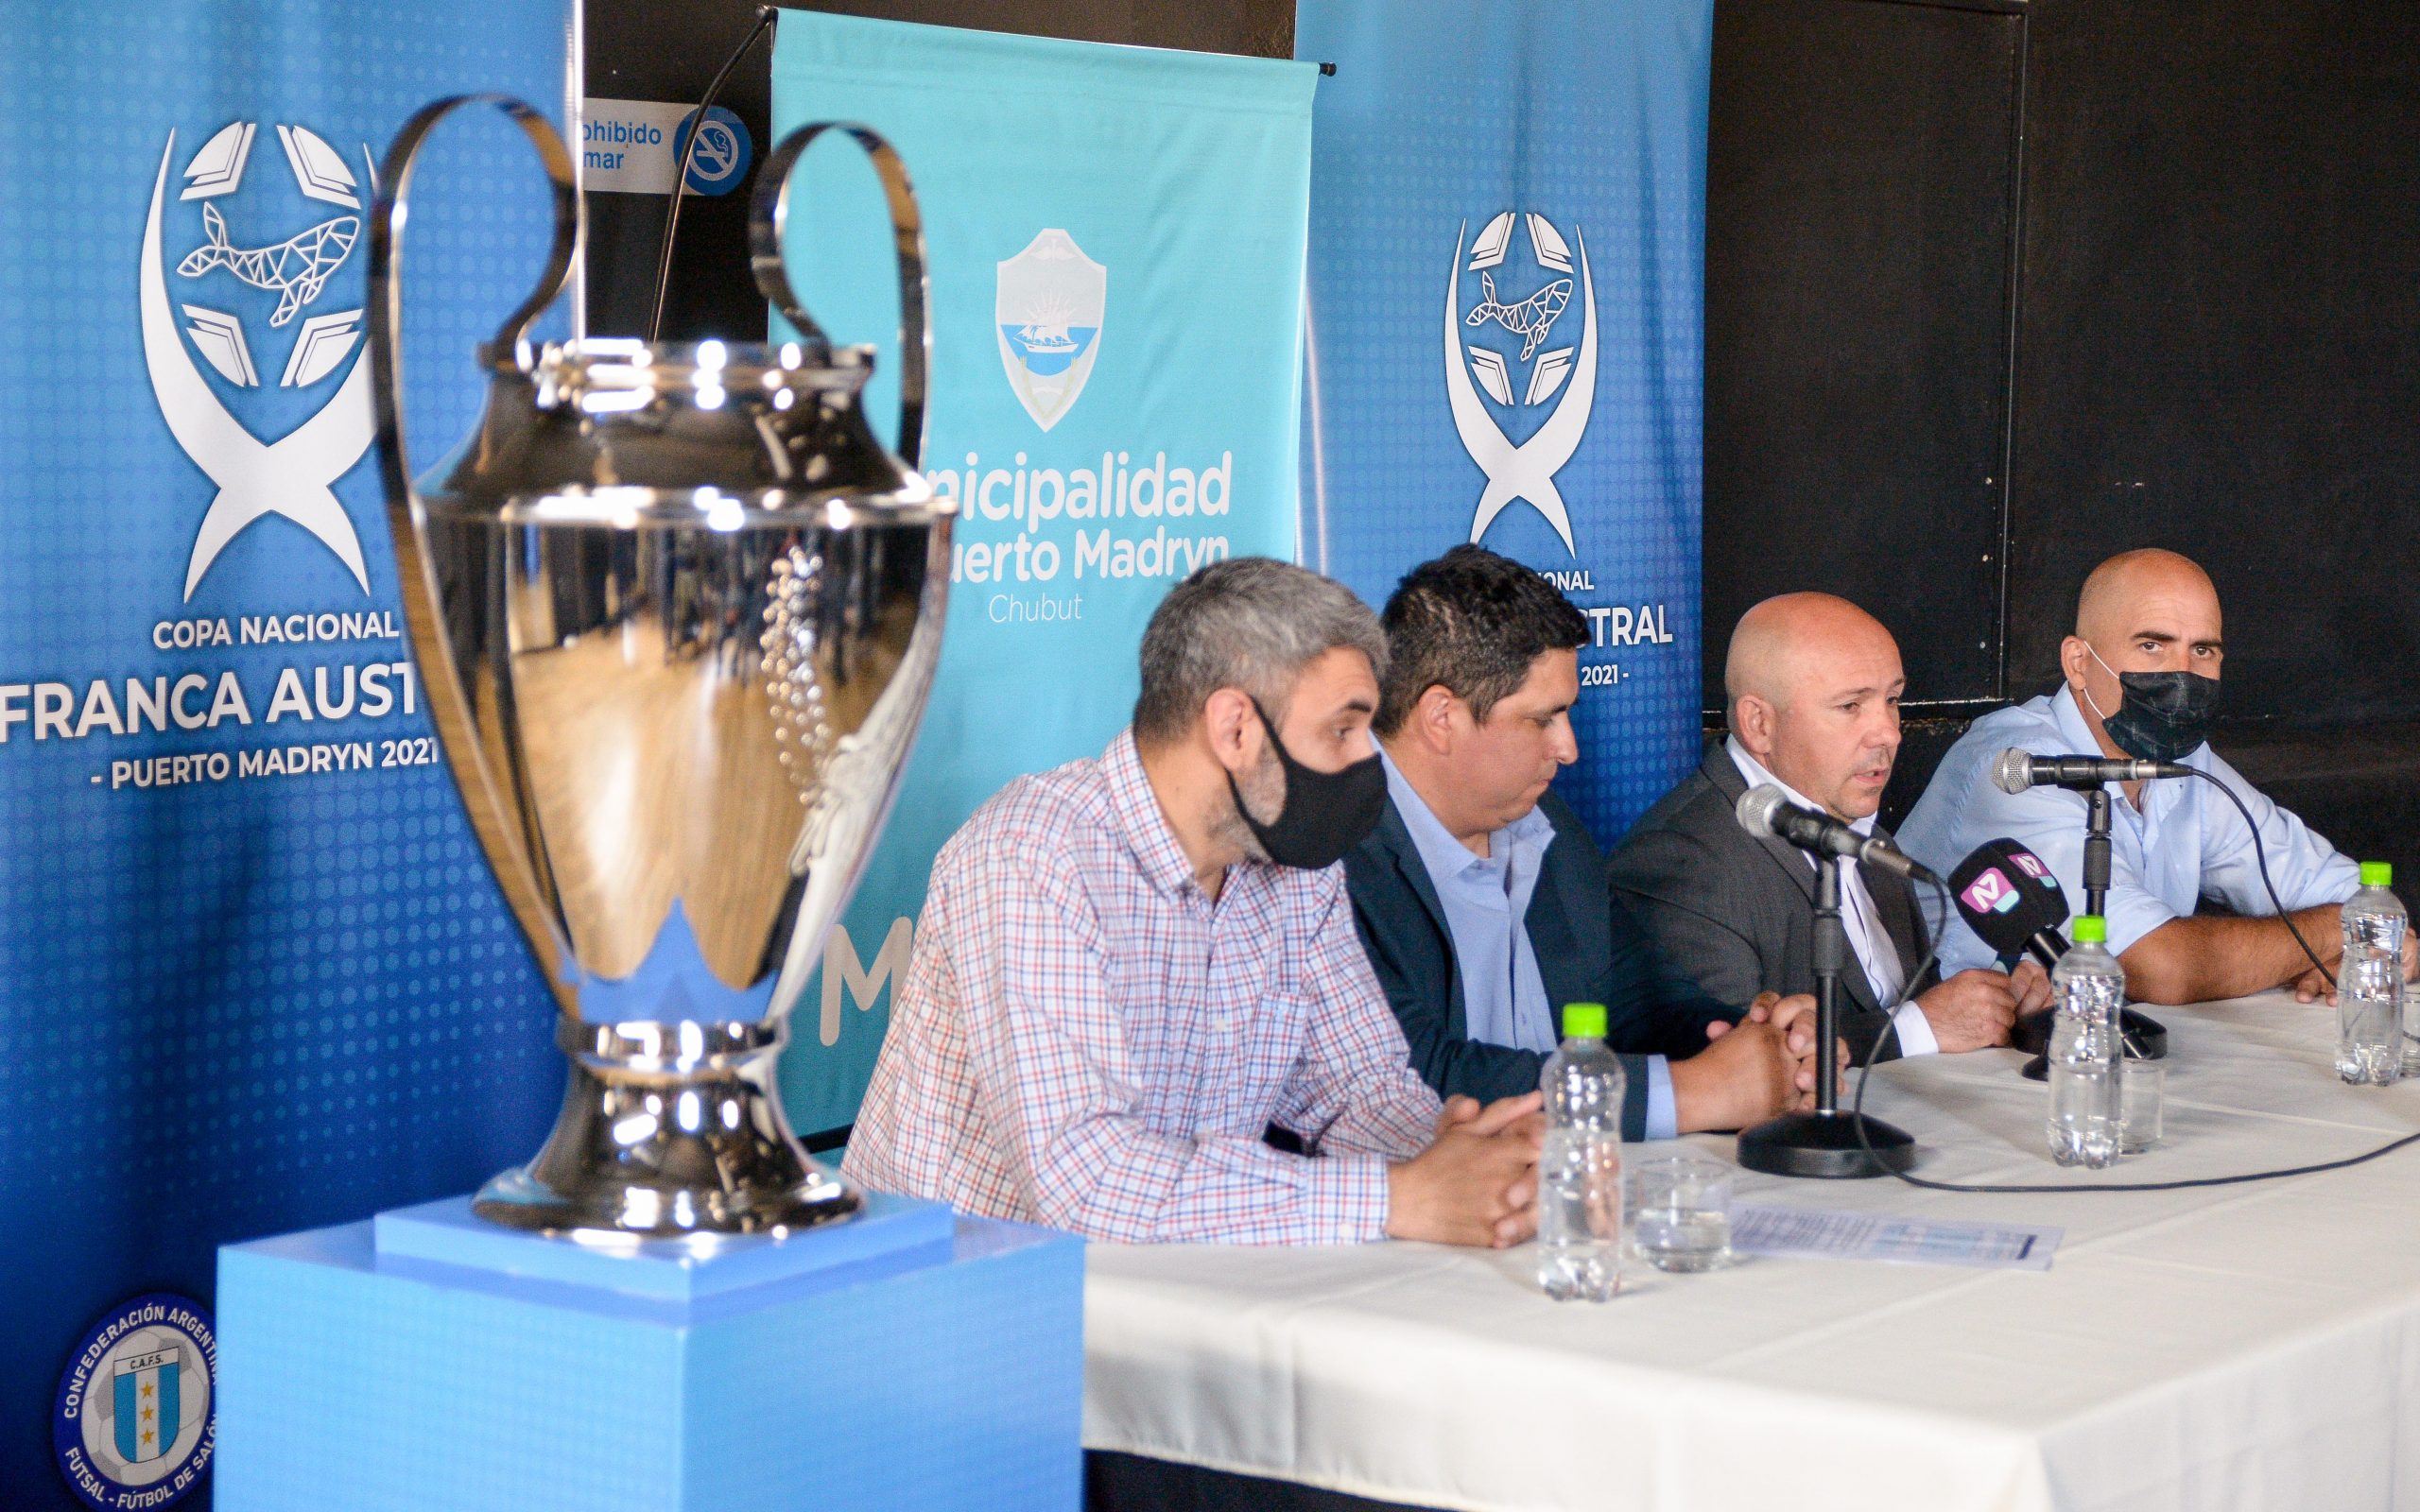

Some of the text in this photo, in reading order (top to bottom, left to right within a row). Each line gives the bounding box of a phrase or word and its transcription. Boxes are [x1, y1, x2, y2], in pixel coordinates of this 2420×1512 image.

[988, 593, 1083, 623] Chubut
[1577, 605, 1673, 647] TRAL
[152, 611, 399, 649] COPA NACIONAL
[1581, 664, 1618, 686] 2021
[0, 672, 251, 743] FRANCA
[112, 753, 230, 788] PUERTO
[238, 742, 372, 778] MADRYN
[380, 737, 439, 767] 2021
[64, 1303, 165, 1419] CONFEDERACIÓN
[130, 1354, 164, 1370] C.A.F.S.
[65, 1447, 109, 1503] FUTSAL
[116, 1485, 174, 1509] FÚTBOL
[174, 1466, 195, 1490] DE
